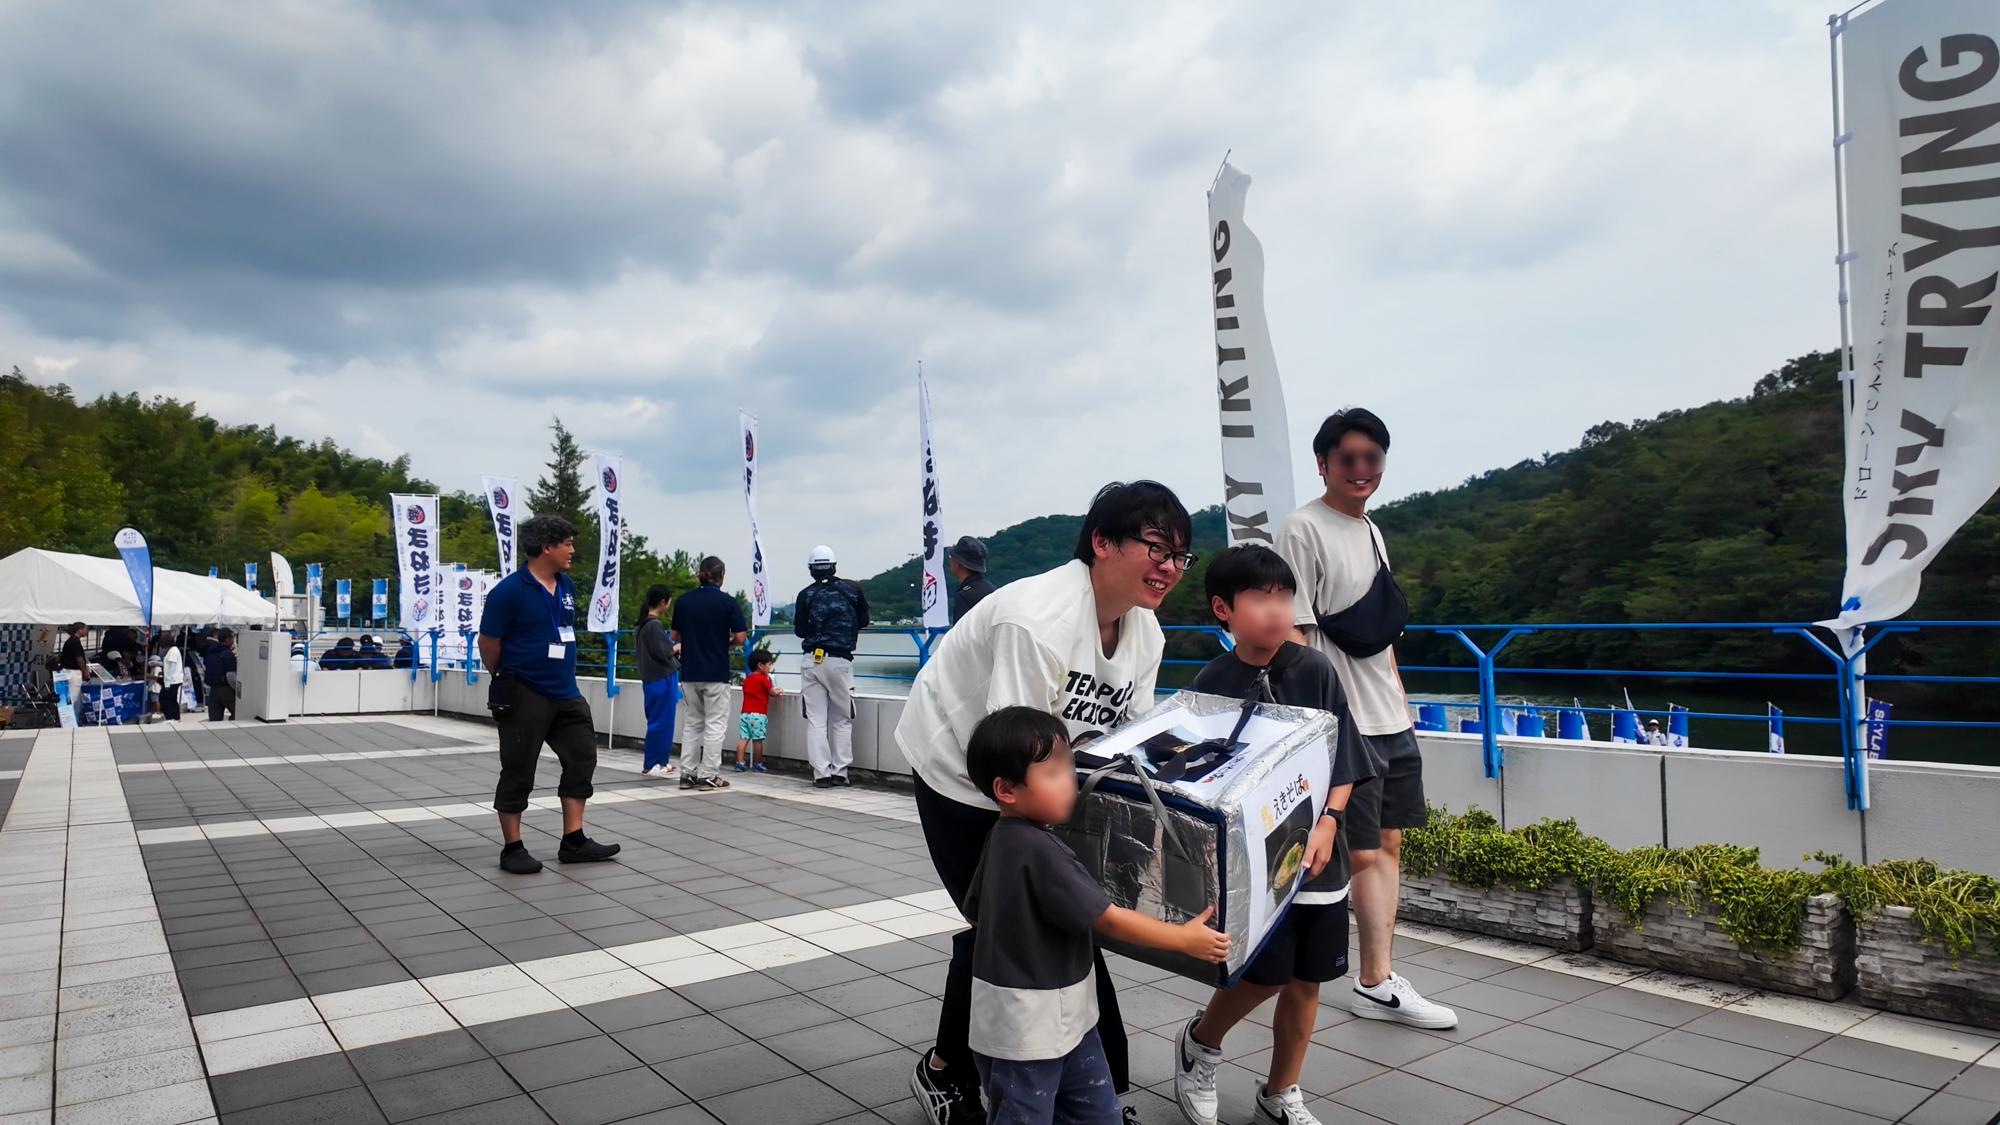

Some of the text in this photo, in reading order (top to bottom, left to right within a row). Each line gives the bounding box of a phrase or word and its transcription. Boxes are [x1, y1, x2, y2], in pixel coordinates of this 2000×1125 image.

[1862, 32, 2000, 566] SKY TRYING
[1224, 473, 1274, 545] KY
[1273, 773, 1306, 820] えきそば
